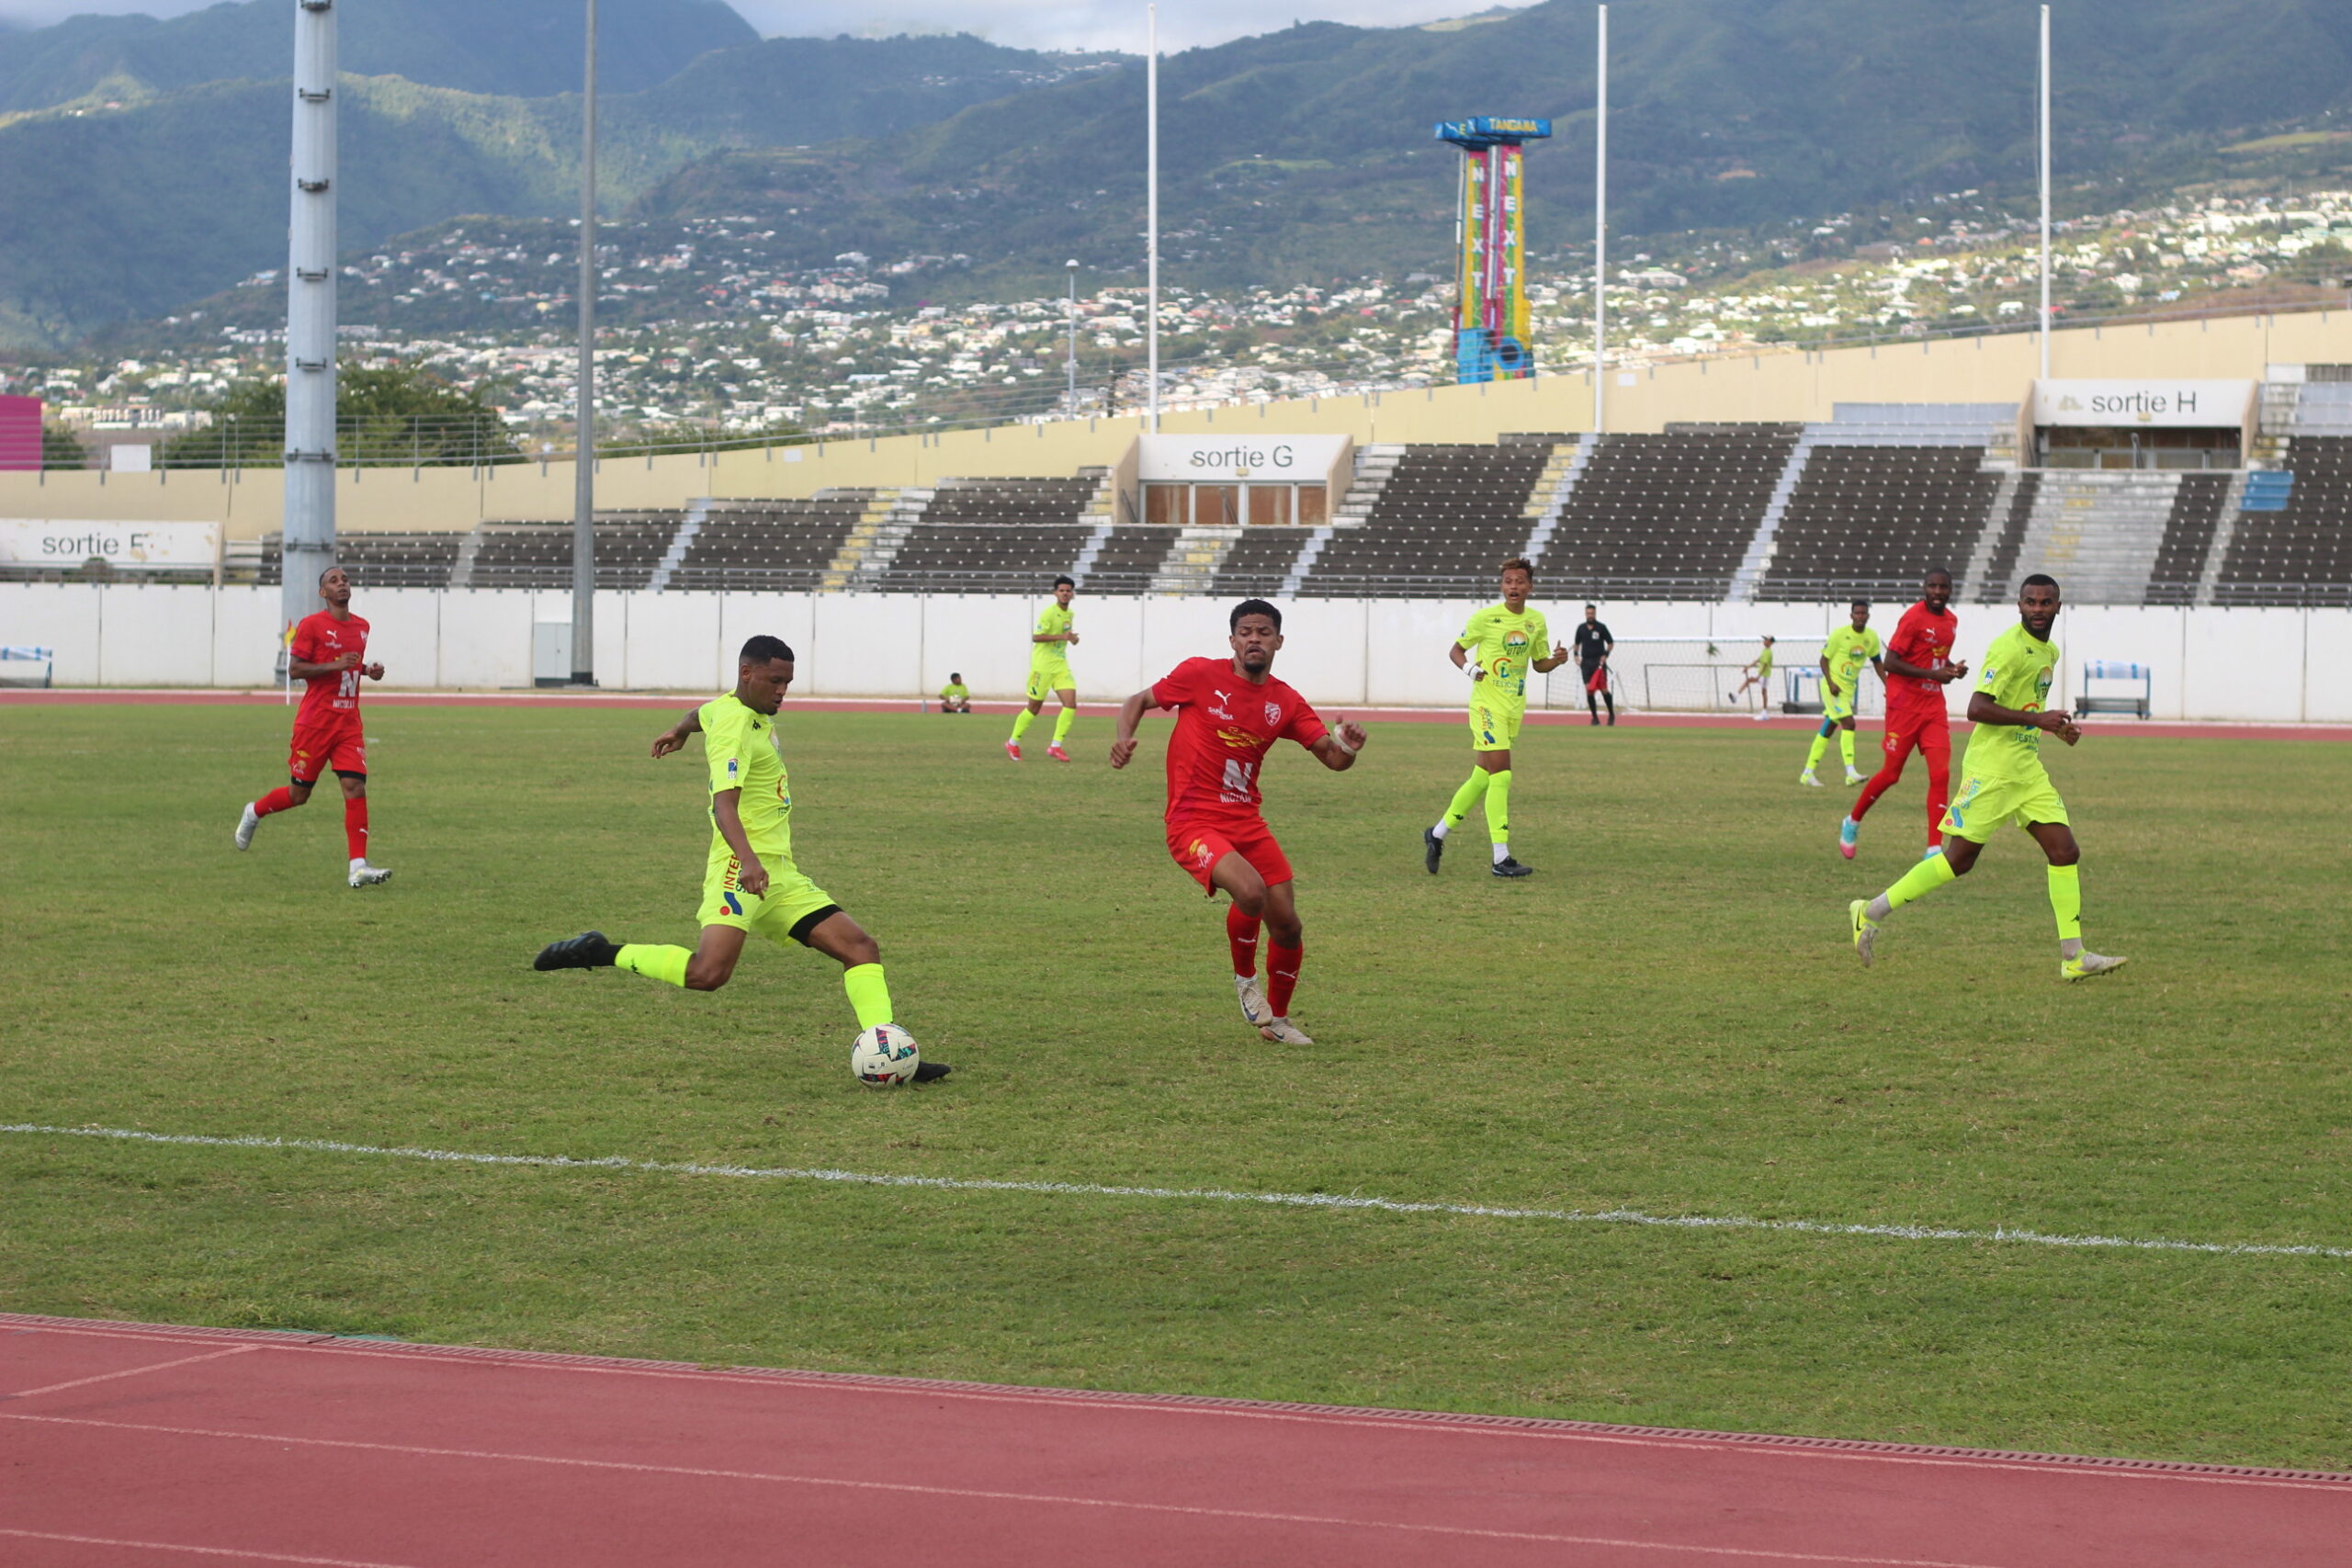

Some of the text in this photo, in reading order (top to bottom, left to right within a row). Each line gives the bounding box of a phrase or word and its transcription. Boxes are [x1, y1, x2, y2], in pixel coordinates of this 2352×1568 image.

[1472, 166, 1485, 288] NEXT
[1504, 161, 1517, 284] NEXT
[2092, 390, 2196, 413] sortie H
[1193, 445, 1294, 468] sortie G
[42, 533, 119, 555] sortie
[338, 670, 359, 698] N
[1221, 759, 1253, 794] N
